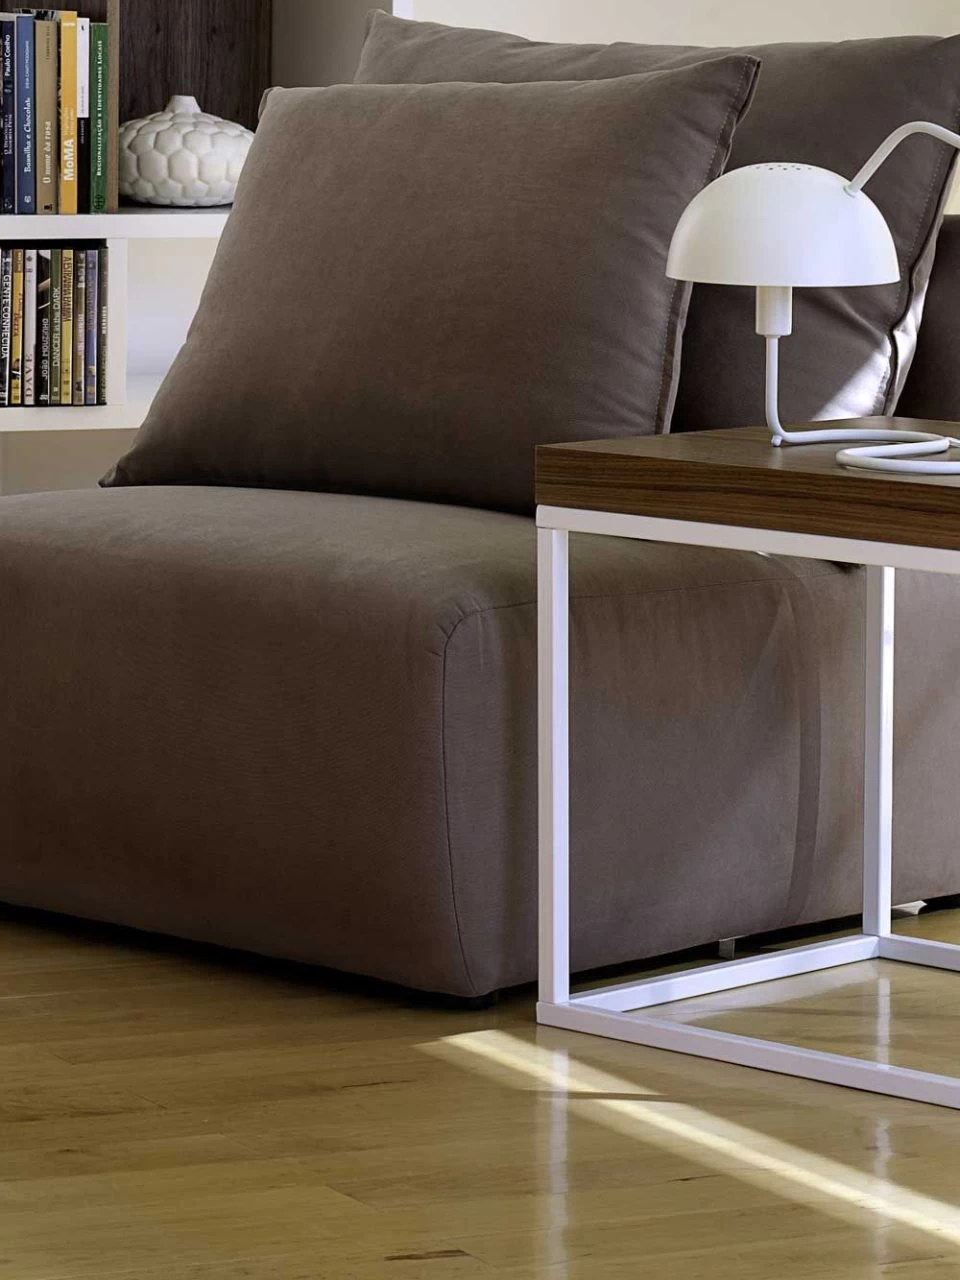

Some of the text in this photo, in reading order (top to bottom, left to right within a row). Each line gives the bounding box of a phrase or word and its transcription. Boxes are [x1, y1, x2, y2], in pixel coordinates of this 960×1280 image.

[95, 66, 103, 111] IDENTIDADES
[43, 121, 51, 141] rosa
[43, 142, 51, 152] da
[95, 119, 103, 176] REGIONALIZAÇÃO
[23, 141, 33, 172] Baunilha
[63, 138, 75, 181] MoMA
[42, 176, 51, 184] O
[1, 274, 10, 358] GENTE CONHECIDA
[25, 353, 33, 398] DAVE
